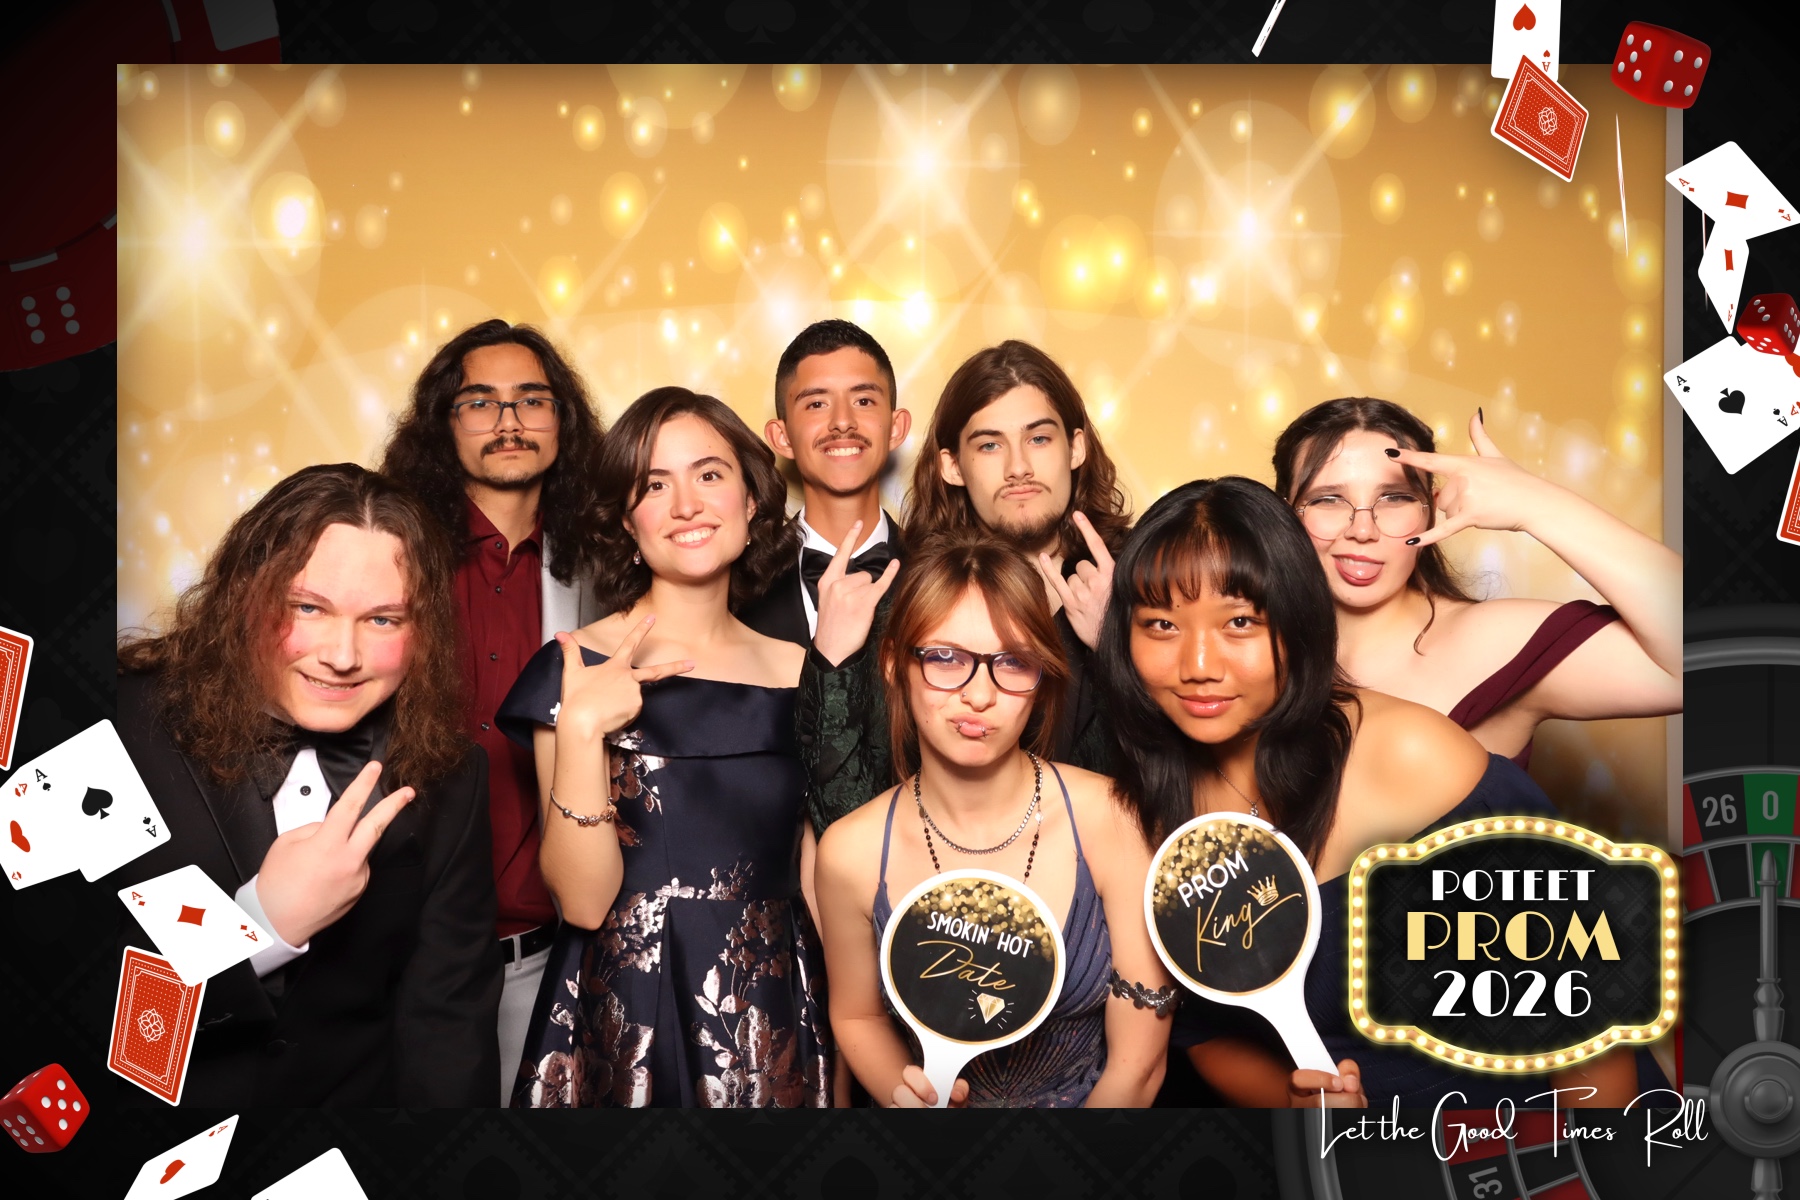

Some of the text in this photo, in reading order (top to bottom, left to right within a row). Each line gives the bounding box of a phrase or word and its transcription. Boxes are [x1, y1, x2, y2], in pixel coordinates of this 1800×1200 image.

[1177, 850, 1249, 908] PROM
[926, 911, 1034, 959] SMOKIN' HOT
[1195, 889, 1303, 973] King
[916, 939, 1016, 992] Date
